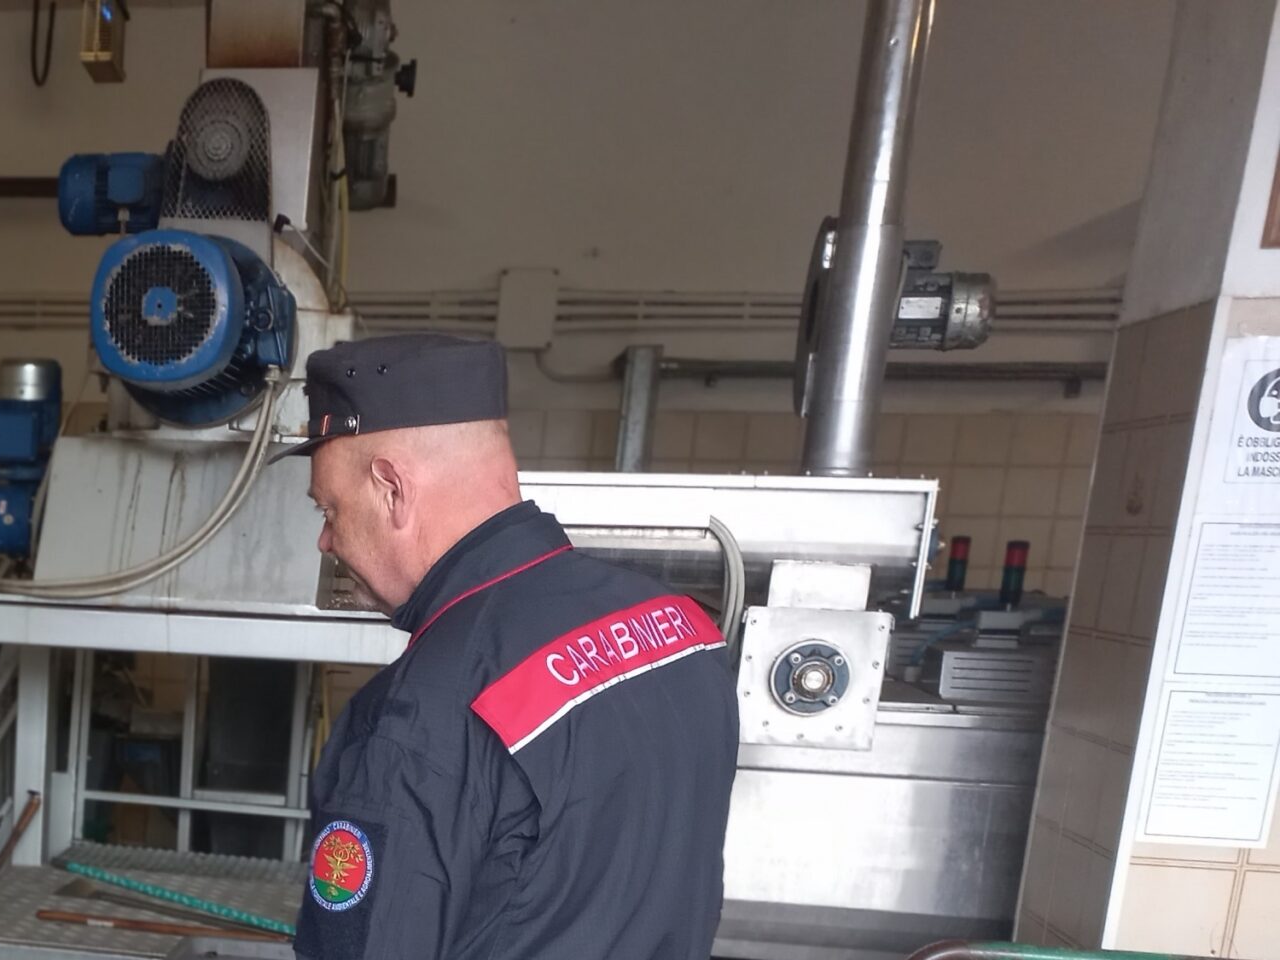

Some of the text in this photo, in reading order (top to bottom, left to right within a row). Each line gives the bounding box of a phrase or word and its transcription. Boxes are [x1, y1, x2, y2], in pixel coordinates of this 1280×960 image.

[1237, 434, 1245, 447] È
[1237, 466, 1280, 477] LA MASC
[546, 605, 697, 686] CARABINIERI
